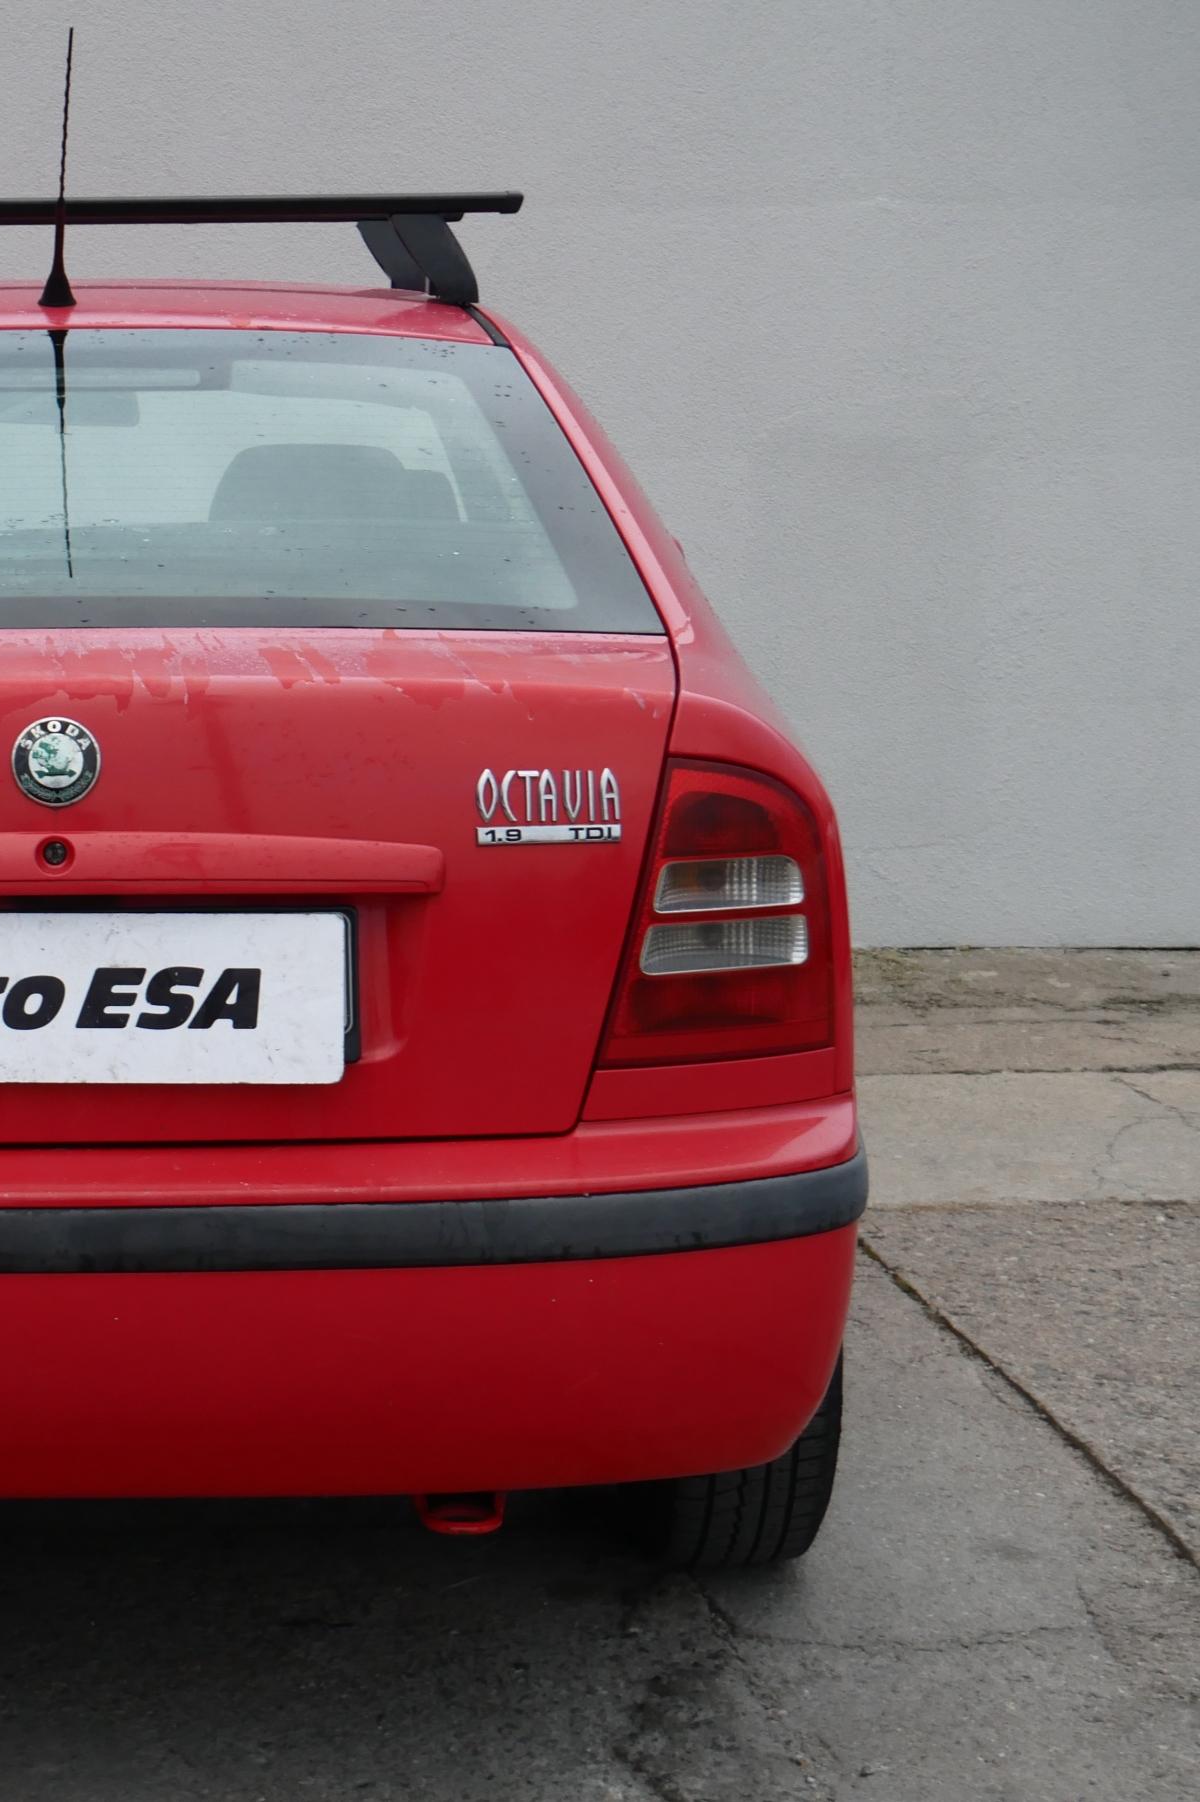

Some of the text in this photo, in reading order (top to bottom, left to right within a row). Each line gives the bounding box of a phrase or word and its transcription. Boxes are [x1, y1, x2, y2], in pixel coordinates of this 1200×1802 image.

[476, 768, 620, 822] OCTAVIA
[485, 827, 613, 842] 1.9 TDI
[75, 966, 262, 1030] ESA
